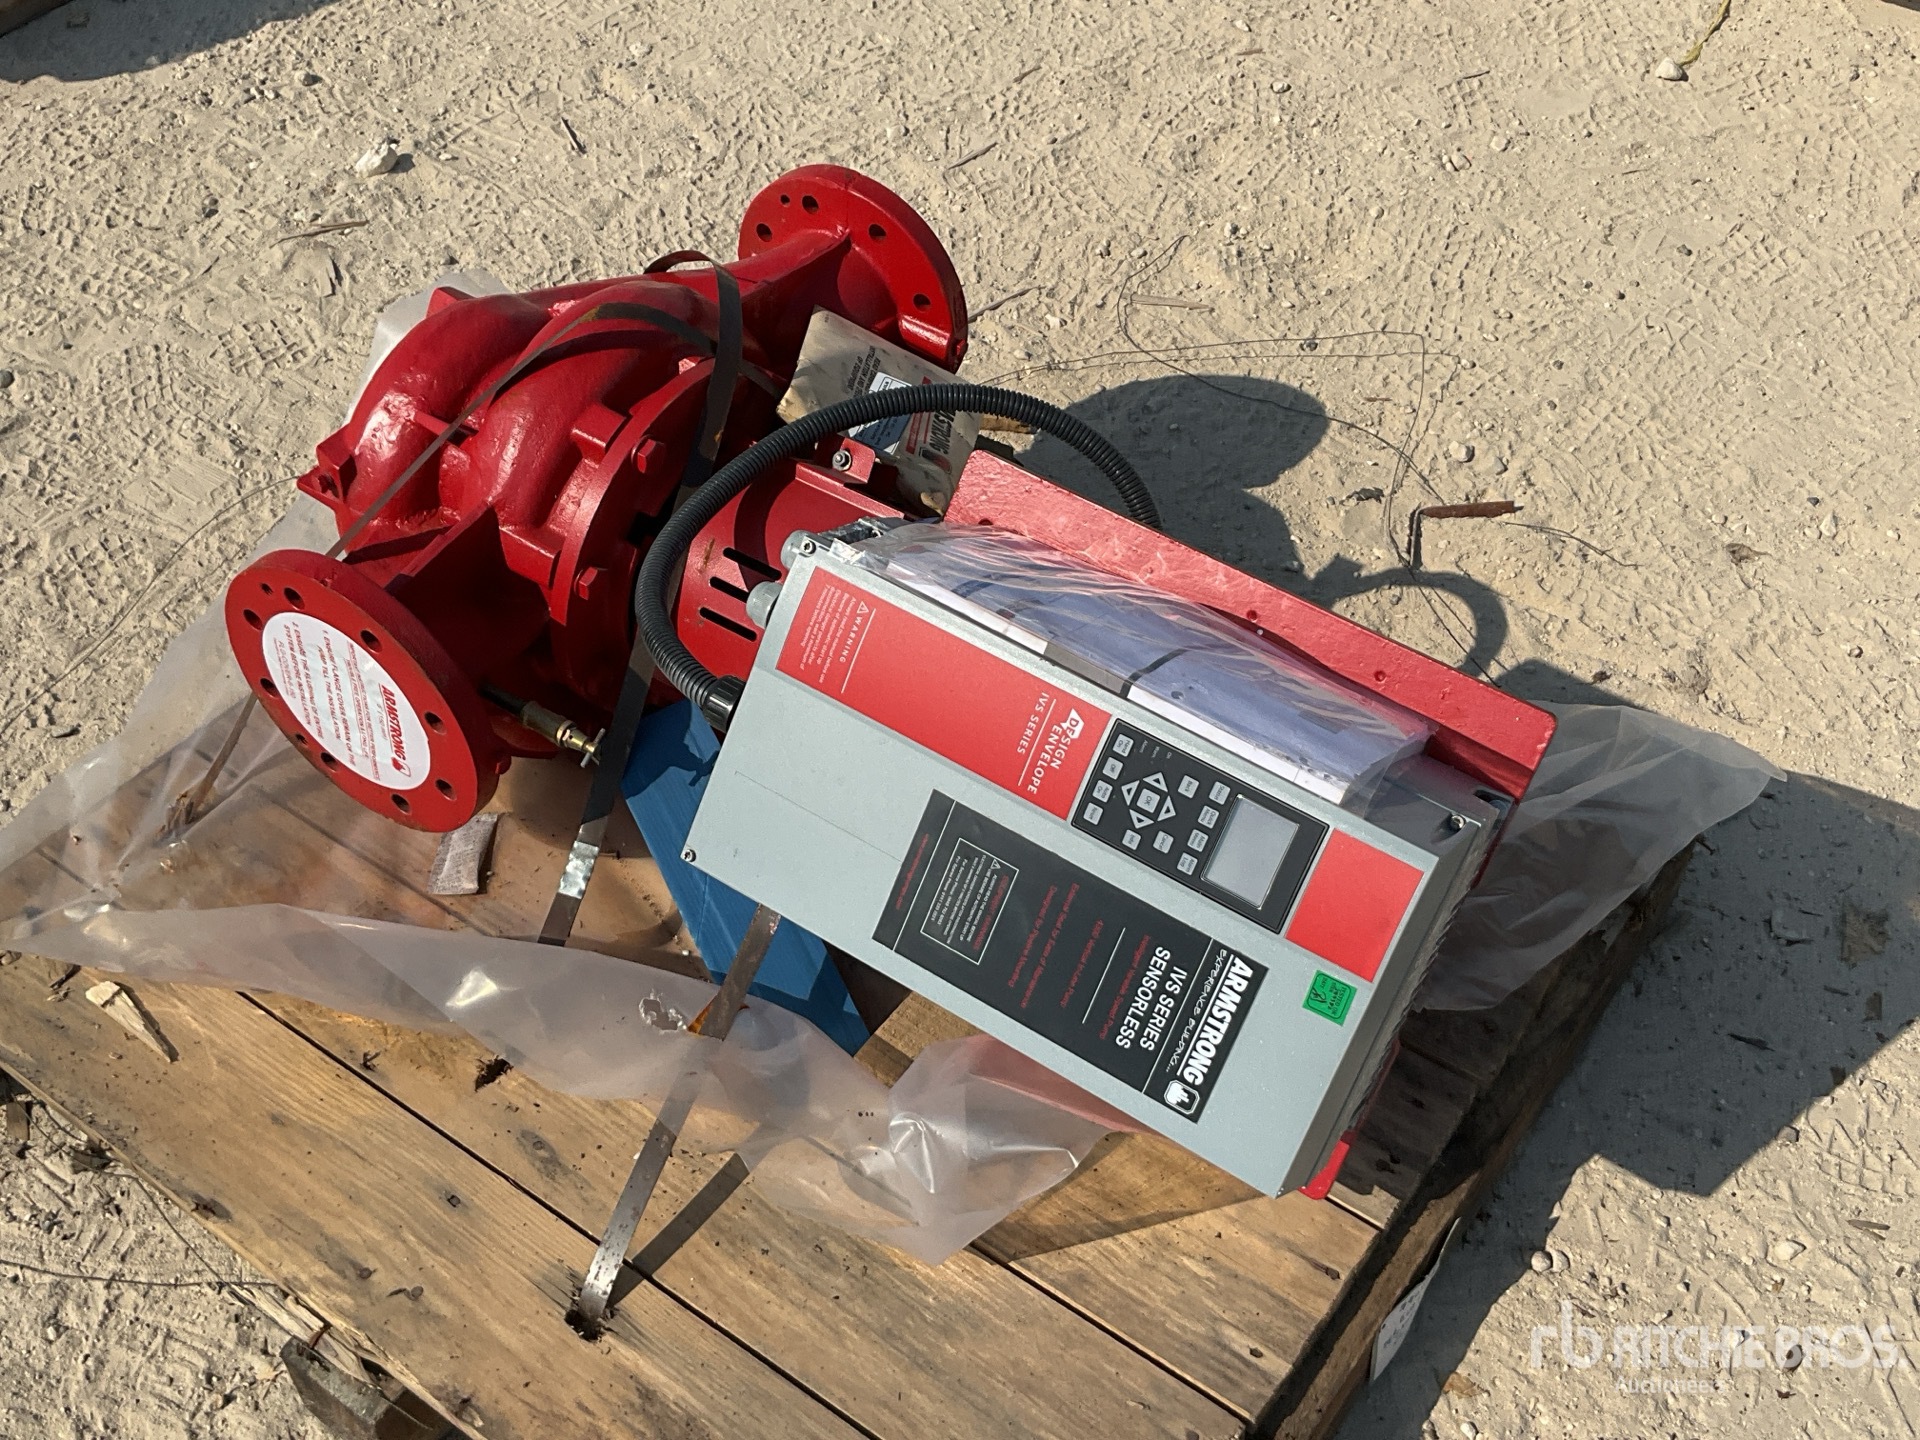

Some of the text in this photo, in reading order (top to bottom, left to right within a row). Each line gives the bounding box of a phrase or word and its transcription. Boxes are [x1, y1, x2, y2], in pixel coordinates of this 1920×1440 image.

[844, 595, 856, 616] Always
[823, 618, 838, 645] automatic
[838, 614, 862, 663] WARNING
[323, 635, 335, 663] ENSURE
[828, 637, 839, 657] manual
[283, 623, 295, 653] SYSTEM
[290, 652, 302, 681] BEFORE
[296, 680, 311, 726] INSTALLATION
[294, 628, 306, 658] ENSURE
[313, 714, 324, 739] ENTIRE
[324, 679, 333, 695] THE
[330, 663, 342, 693] FLANGE
[326, 693, 341, 741] INSTALLATION
[335, 691, 346, 717] COVER
[340, 716, 352, 743] REMAIN
[380, 683, 408, 763] ARMSTRONG
[1015, 691, 1049, 755] IVS SERIES
[1049, 716, 1080, 770] DESIGN
[1116, 739, 1124, 748] On
[1120, 739, 1130, 754] Hand
[1025, 724, 1063, 794] ENVELOPE
[1183, 779, 1193, 792] Back
[1143, 794, 1153, 806] OK
[1199, 807, 1210, 823] Menu
[1205, 810, 1216, 826] Quick
[1157, 833, 1169, 850] Cancel
[1195, 834, 1205, 849] Main
[1189, 947, 1228, 1017] EXPERIENCE
[1113, 945, 1172, 1050] SENSORLESS
[1137, 965, 1188, 1052] IVS SERIES
[1097, 1016, 1113, 1040] Pump
[1179, 956, 1256, 1087] ARMSTRONG
